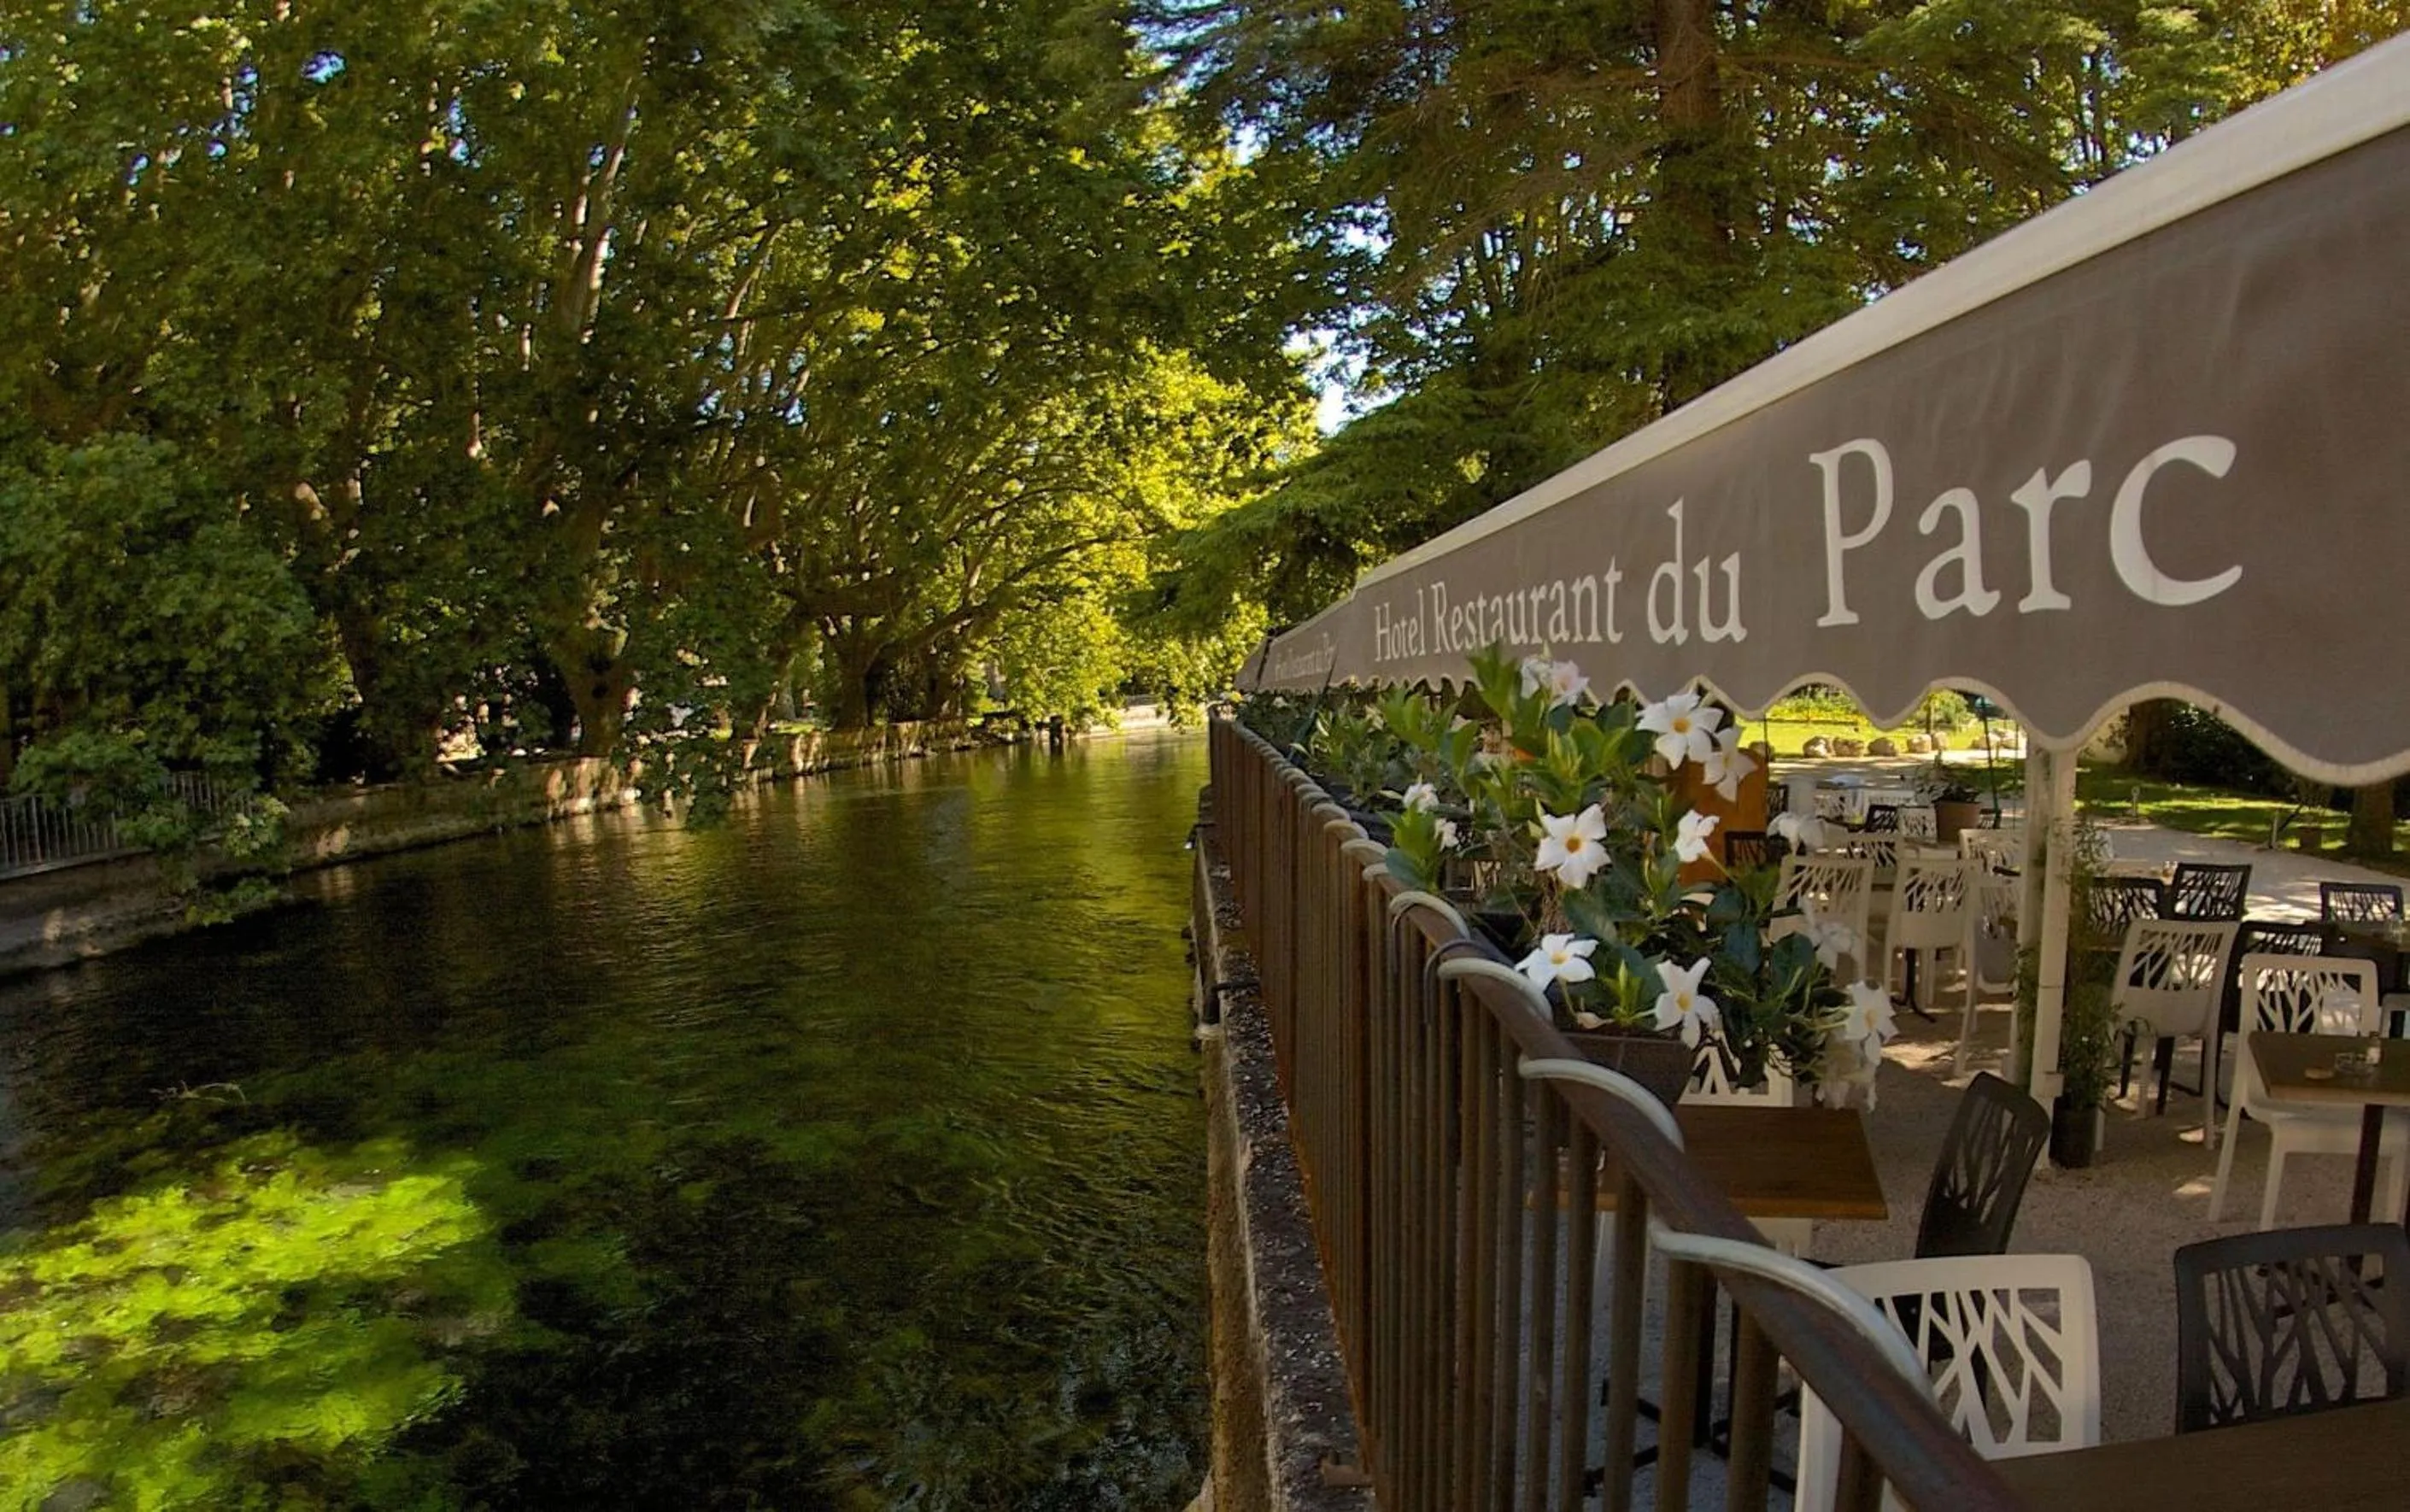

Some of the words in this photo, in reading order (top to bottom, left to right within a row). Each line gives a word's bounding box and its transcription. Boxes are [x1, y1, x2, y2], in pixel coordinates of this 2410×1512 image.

[1374, 588, 1427, 663] Hotel
[1430, 556, 1623, 656] Restaurant
[1646, 497, 1748, 646] du
[1809, 435, 2243, 627] Parc
